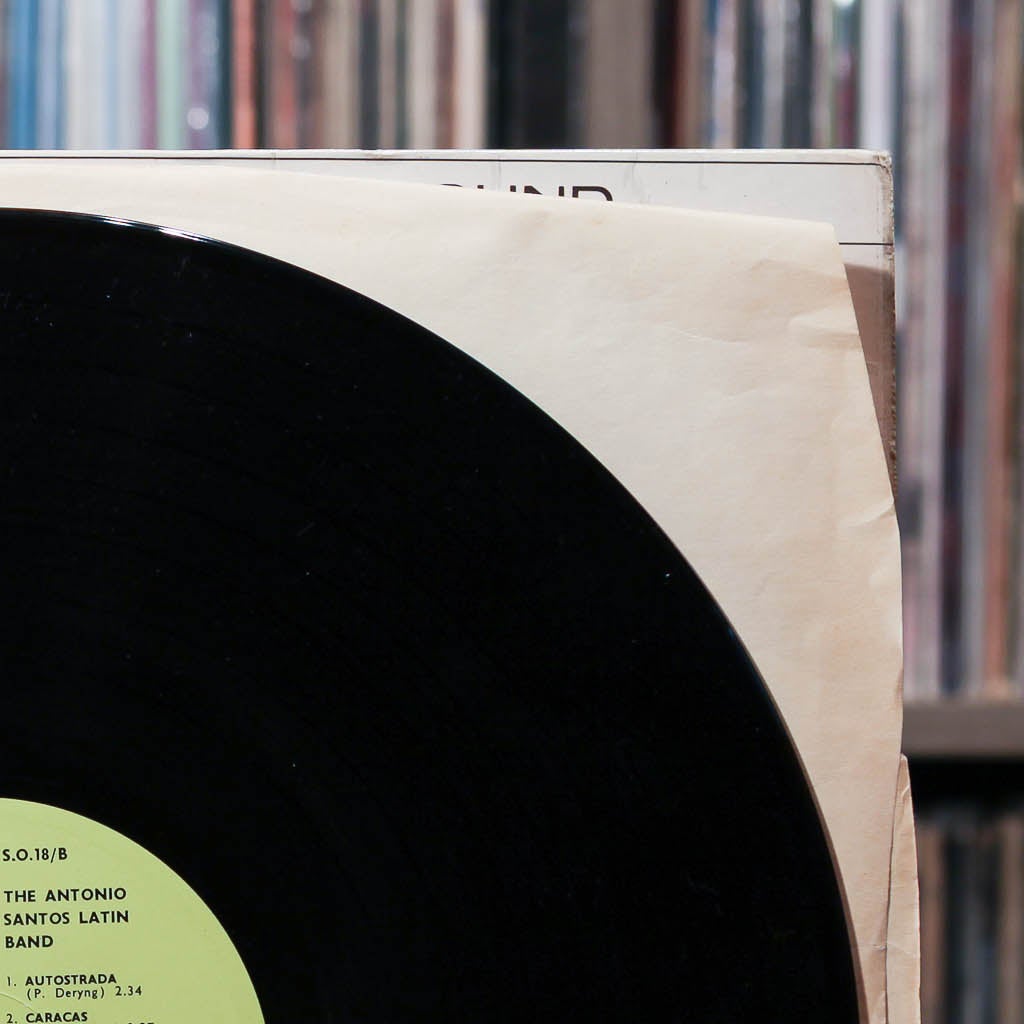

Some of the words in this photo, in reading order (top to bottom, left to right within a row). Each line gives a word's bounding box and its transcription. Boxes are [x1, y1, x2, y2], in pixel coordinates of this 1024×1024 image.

[2, 847, 68, 863] S.O.18/B
[4, 889, 36, 903] THE
[45, 887, 127, 902] ANTONIO
[3, 912, 70, 926] SANTOS
[79, 910, 130, 924] LATIN
[5, 935, 54, 949] BAND
[7, 976, 17, 987] 1.
[25, 974, 117, 986] AUTOSTRADA
[55, 987, 105, 1000] Deryng)
[115, 986, 143, 997] 2.34
[6, 1013, 18, 1024] 2.
[25, 1011, 88, 1023] CARACAS
